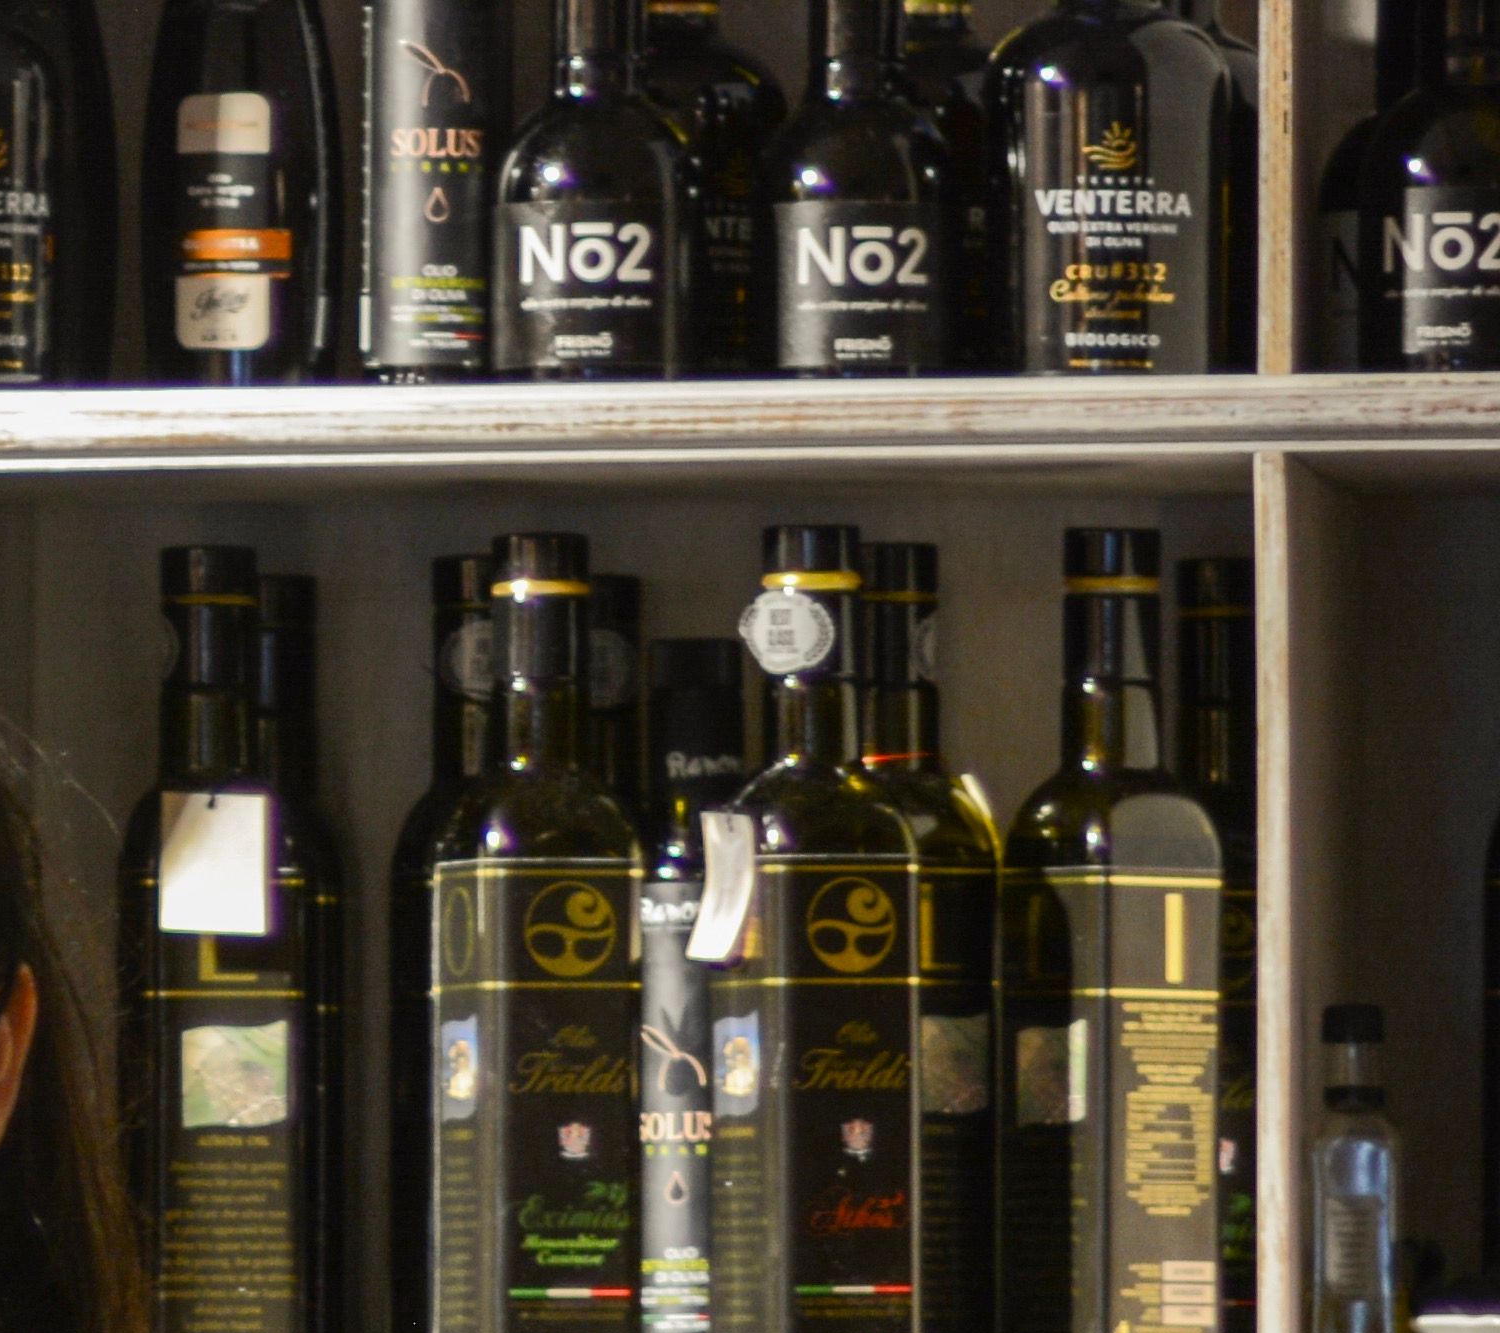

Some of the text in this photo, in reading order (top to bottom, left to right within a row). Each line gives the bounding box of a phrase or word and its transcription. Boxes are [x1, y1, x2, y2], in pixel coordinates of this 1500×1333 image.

[391, 127, 483, 157] SOLUS
[1035, 190, 1191, 217] VENTERRA
[422, 265, 457, 277] OLIO
[1065, 333, 1160, 347] BIOLOGICO
